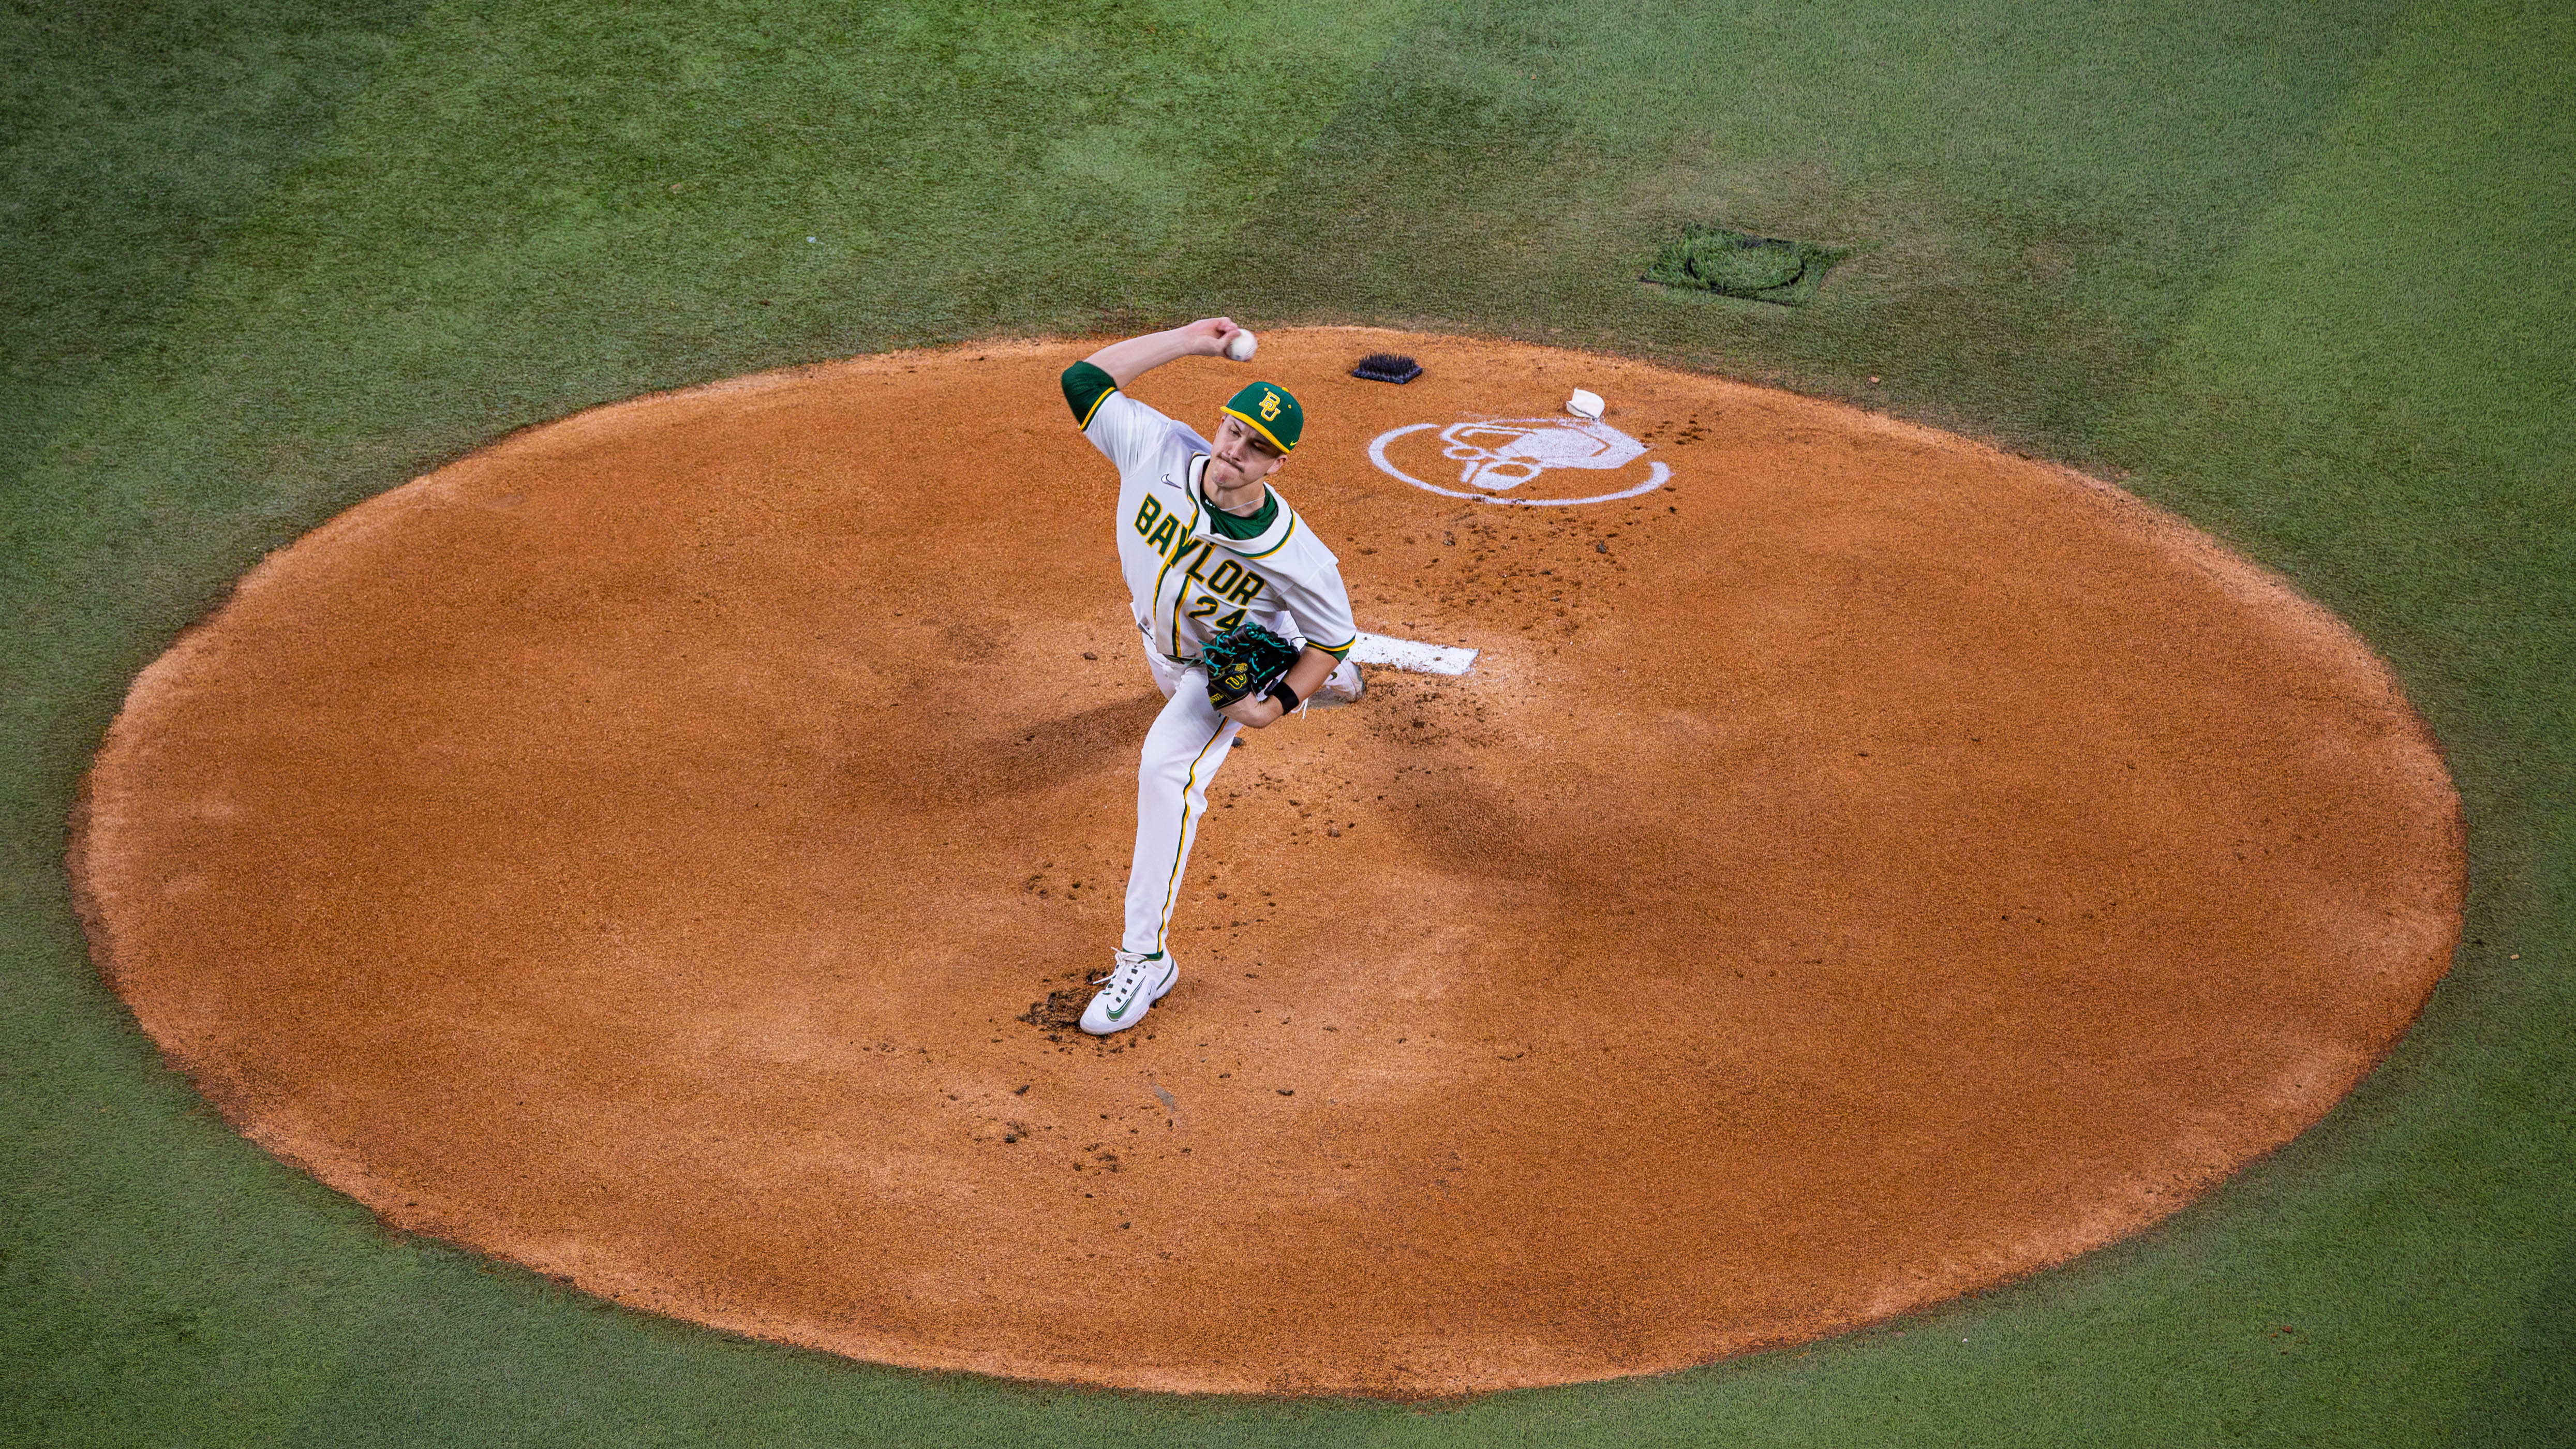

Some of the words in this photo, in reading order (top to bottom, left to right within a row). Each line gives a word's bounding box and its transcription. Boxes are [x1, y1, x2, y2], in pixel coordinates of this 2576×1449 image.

[1259, 391, 1281, 422] BU
[1134, 492, 1266, 606] BAYLOR
[1188, 595, 1248, 631] 24
